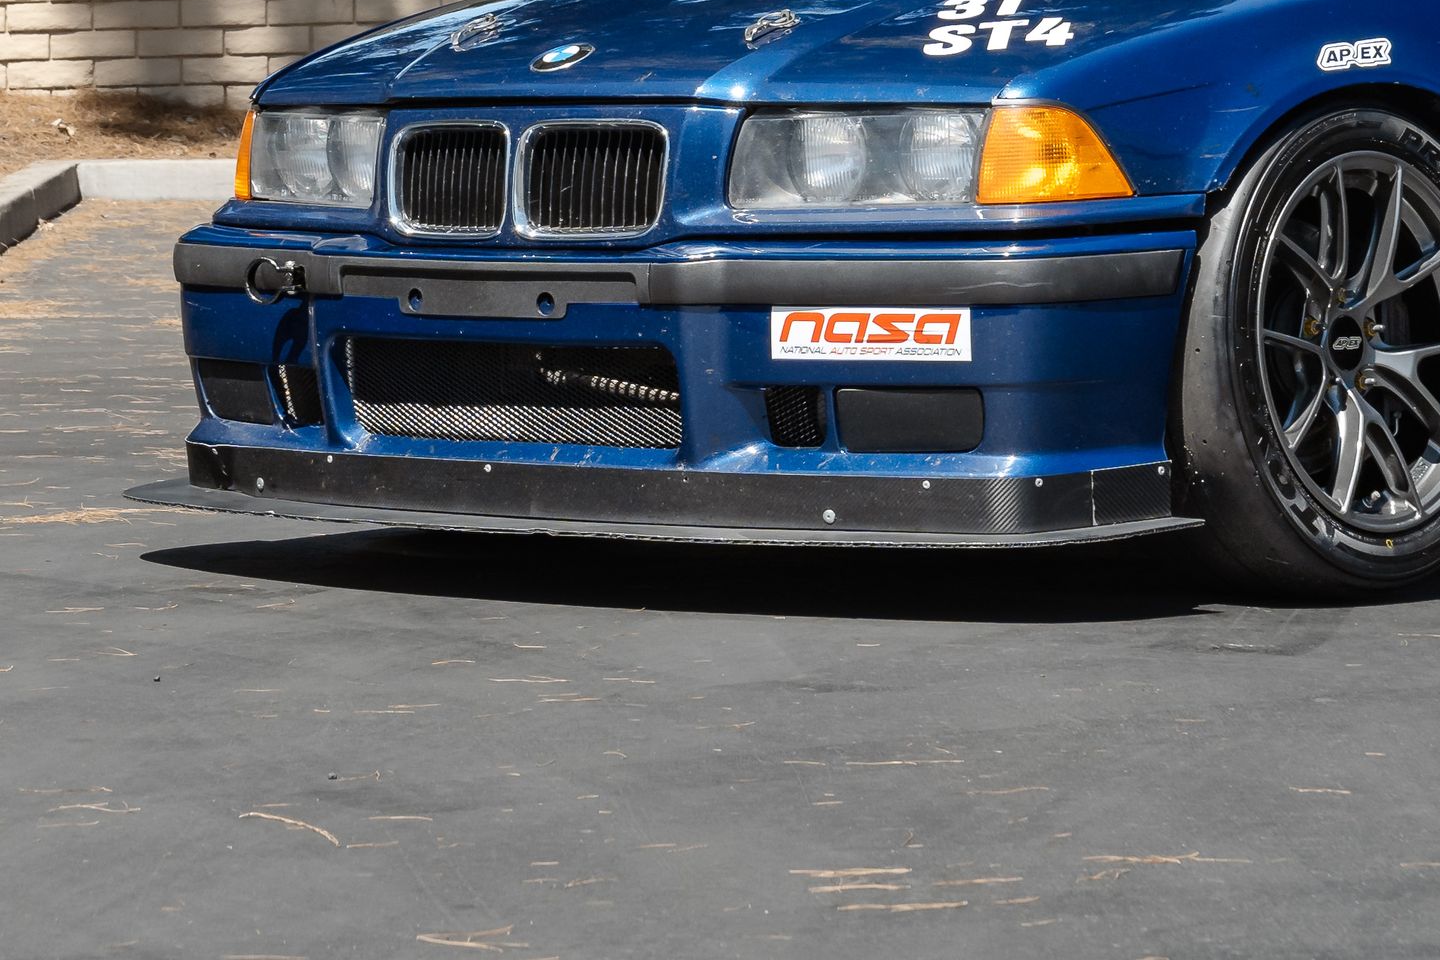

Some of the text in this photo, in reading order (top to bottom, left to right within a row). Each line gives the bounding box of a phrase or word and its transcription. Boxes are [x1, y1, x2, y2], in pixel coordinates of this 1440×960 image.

[922, 17, 1075, 56] ST4
[779, 311, 962, 345] nasa
[780, 346, 962, 356] NATIONAL AUTO SPORT ASSOCIATION
